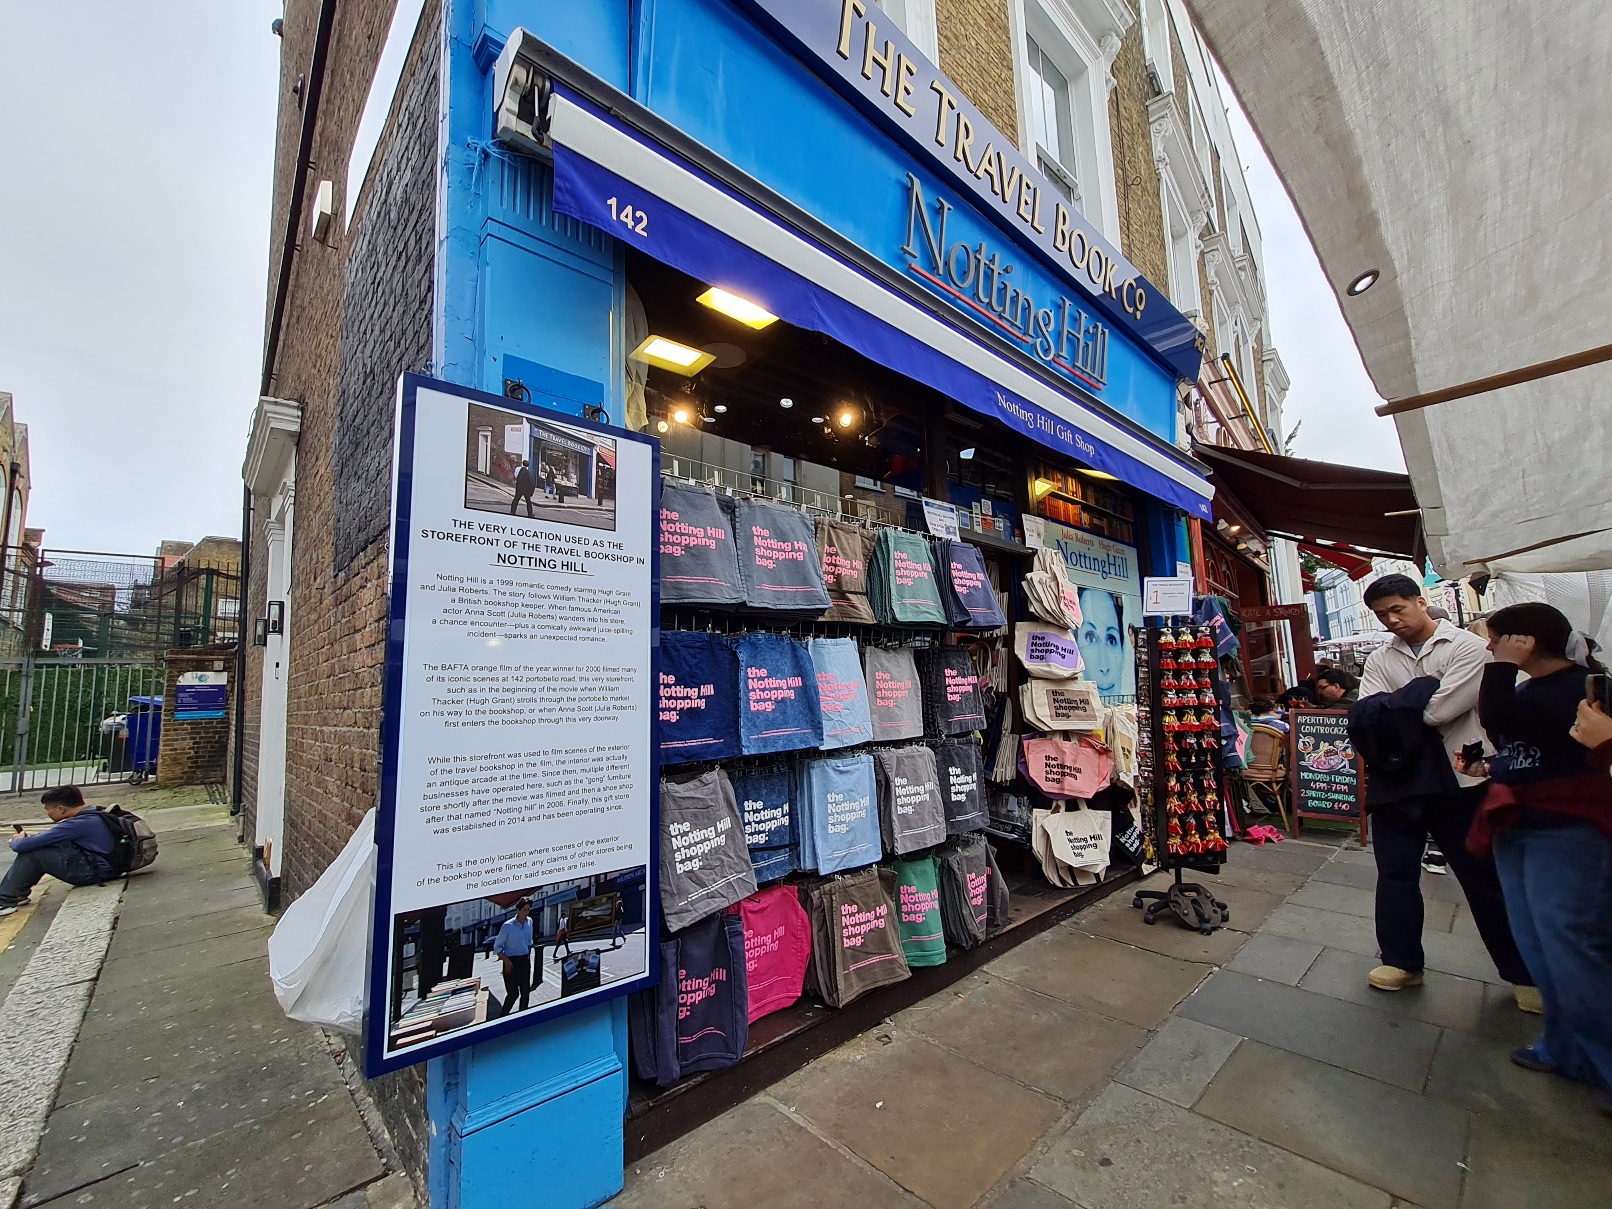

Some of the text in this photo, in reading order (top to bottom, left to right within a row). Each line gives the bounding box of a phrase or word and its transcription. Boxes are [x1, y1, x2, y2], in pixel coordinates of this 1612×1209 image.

[836, 0, 918, 117] THE
[930, 80, 1046, 235] TRAVEL
[1053, 202, 1119, 300] BOOK
[607, 196, 648, 237] 142
[901, 172, 1109, 385] Notting Hill
[996, 391, 1095, 457] Notting Hill Gift Shop
[451, 519, 624, 550] THE VERY LOCATION USED AS THE
[707, 526, 725, 539] Hill
[752, 526, 770, 537] the
[420, 530, 644, 565] STOREFRONT OF THE TRAVEL BOOKSHOP IN
[753, 536, 792, 551] Notting
[755, 546, 804, 561] shopping
[894, 550, 908, 560] the
[1056, 539, 1129, 579] Notting Hill
[497, 552, 587, 573] NOTTING HILL
[895, 559, 923, 571] Notting
[436, 573, 464, 584] Notting
[466, 575, 478, 583] Hill
[480, 576, 486, 584] is
[496, 577, 513, 586] 1999
[895, 569, 928, 580] shopping
[1030, 647, 1066, 660] shopping
[1031, 641, 1074, 655] Notting Hill
[422, 663, 438, 671] The
[440, 663, 469, 671] BAFTA
[470, 665, 497, 673] orange
[747, 667, 767, 678] the
[748, 677, 803, 690] Notting Hill
[749, 689, 795, 701] shopping
[427, 754, 451, 764] While
[453, 753, 467, 762] this
[469, 751, 505, 761] storefront
[1044, 754, 1059, 762] the
[1044, 762, 1072, 772] Notting
[1045, 769, 1078, 780] shopping
[895, 777, 907, 787] the
[895, 781, 934, 797] Notting Hill
[827, 792, 844, 802] the
[896, 793, 930, 806] shopping
[743, 800, 764, 811] the
[828, 795, 870, 813] Notting Hill
[744, 807, 782, 823] Notting
[828, 809, 866, 824] shopping
[669, 821, 691, 836] the
[744, 815, 789, 834] shopping
[671, 816, 732, 850] Notting Hill
[674, 834, 726, 862] shopping
[466, 880, 479, 889] the
[480, 874, 510, 887] location
[512, 872, 522, 881] for
[900, 885, 917, 895] the
[900, 891, 931, 904] Notting
[841, 903, 858, 916] the
[901, 900, 939, 913] shopping
[842, 904, 888, 927] Notting Hill
[842, 918, 885, 936] shopping
[744, 925, 786, 949] otting Hill
